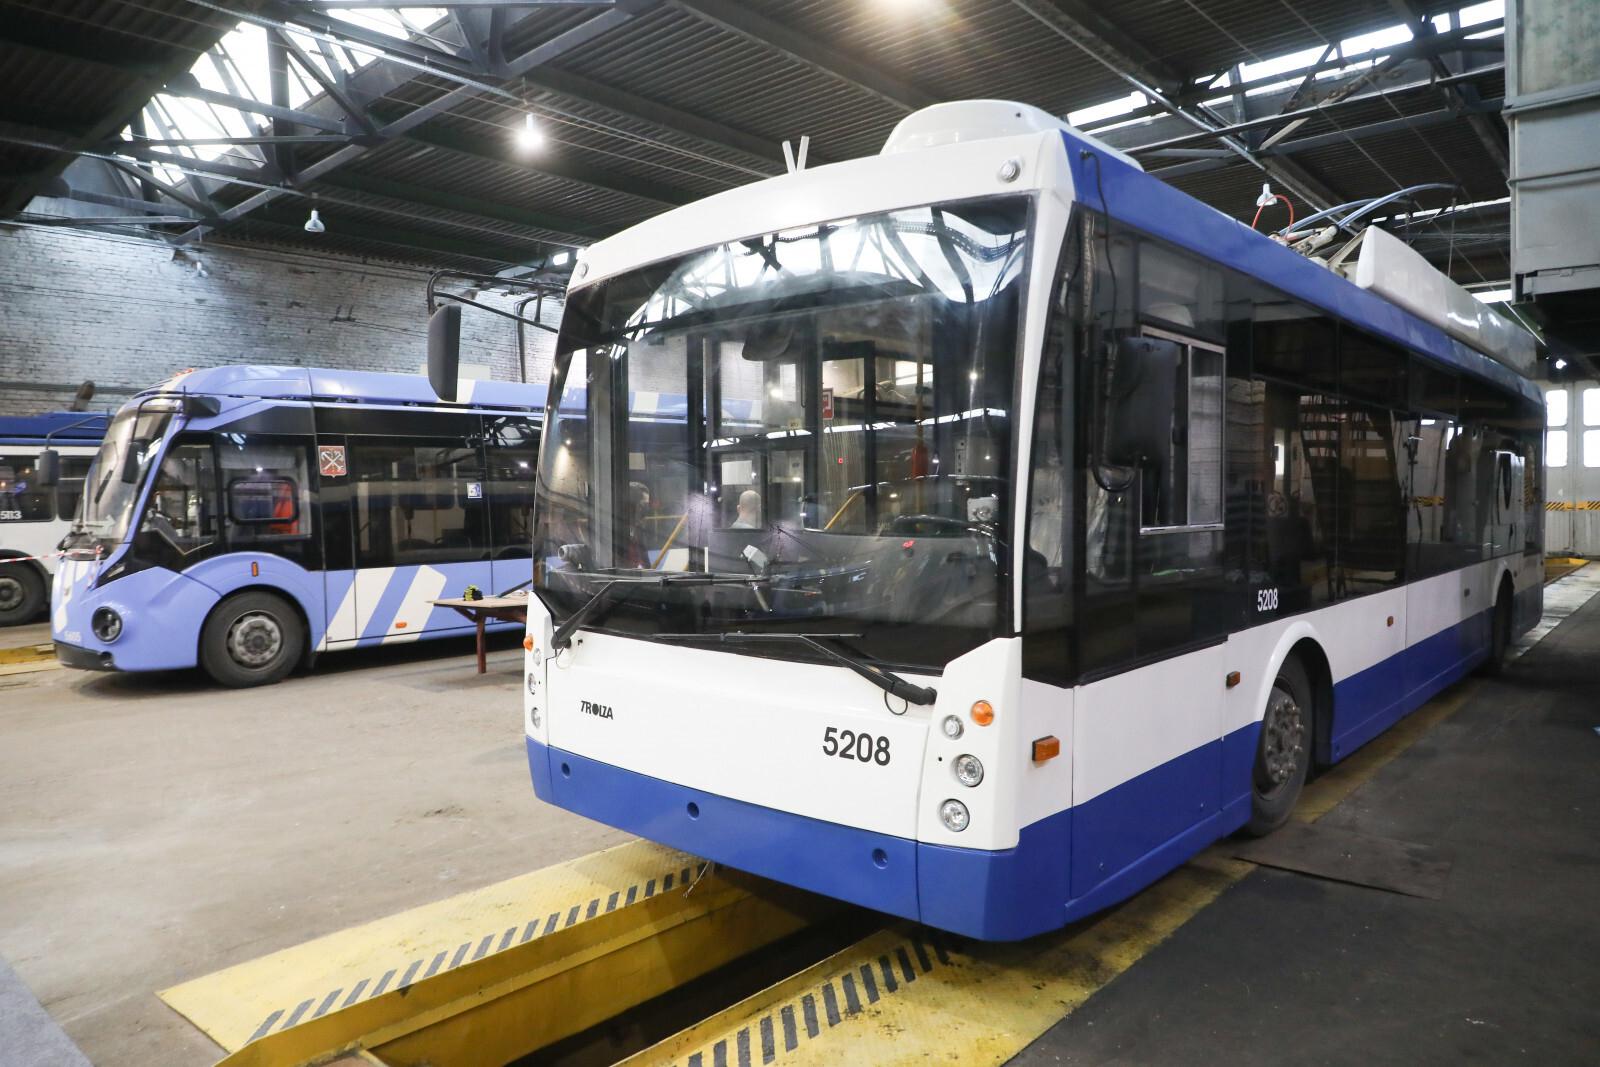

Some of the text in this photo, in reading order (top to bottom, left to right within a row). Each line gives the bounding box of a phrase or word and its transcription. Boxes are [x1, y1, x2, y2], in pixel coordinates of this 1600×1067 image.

[1257, 587, 1279, 612] 5208
[580, 700, 614, 721] TROLZA
[822, 726, 891, 767] 5208
